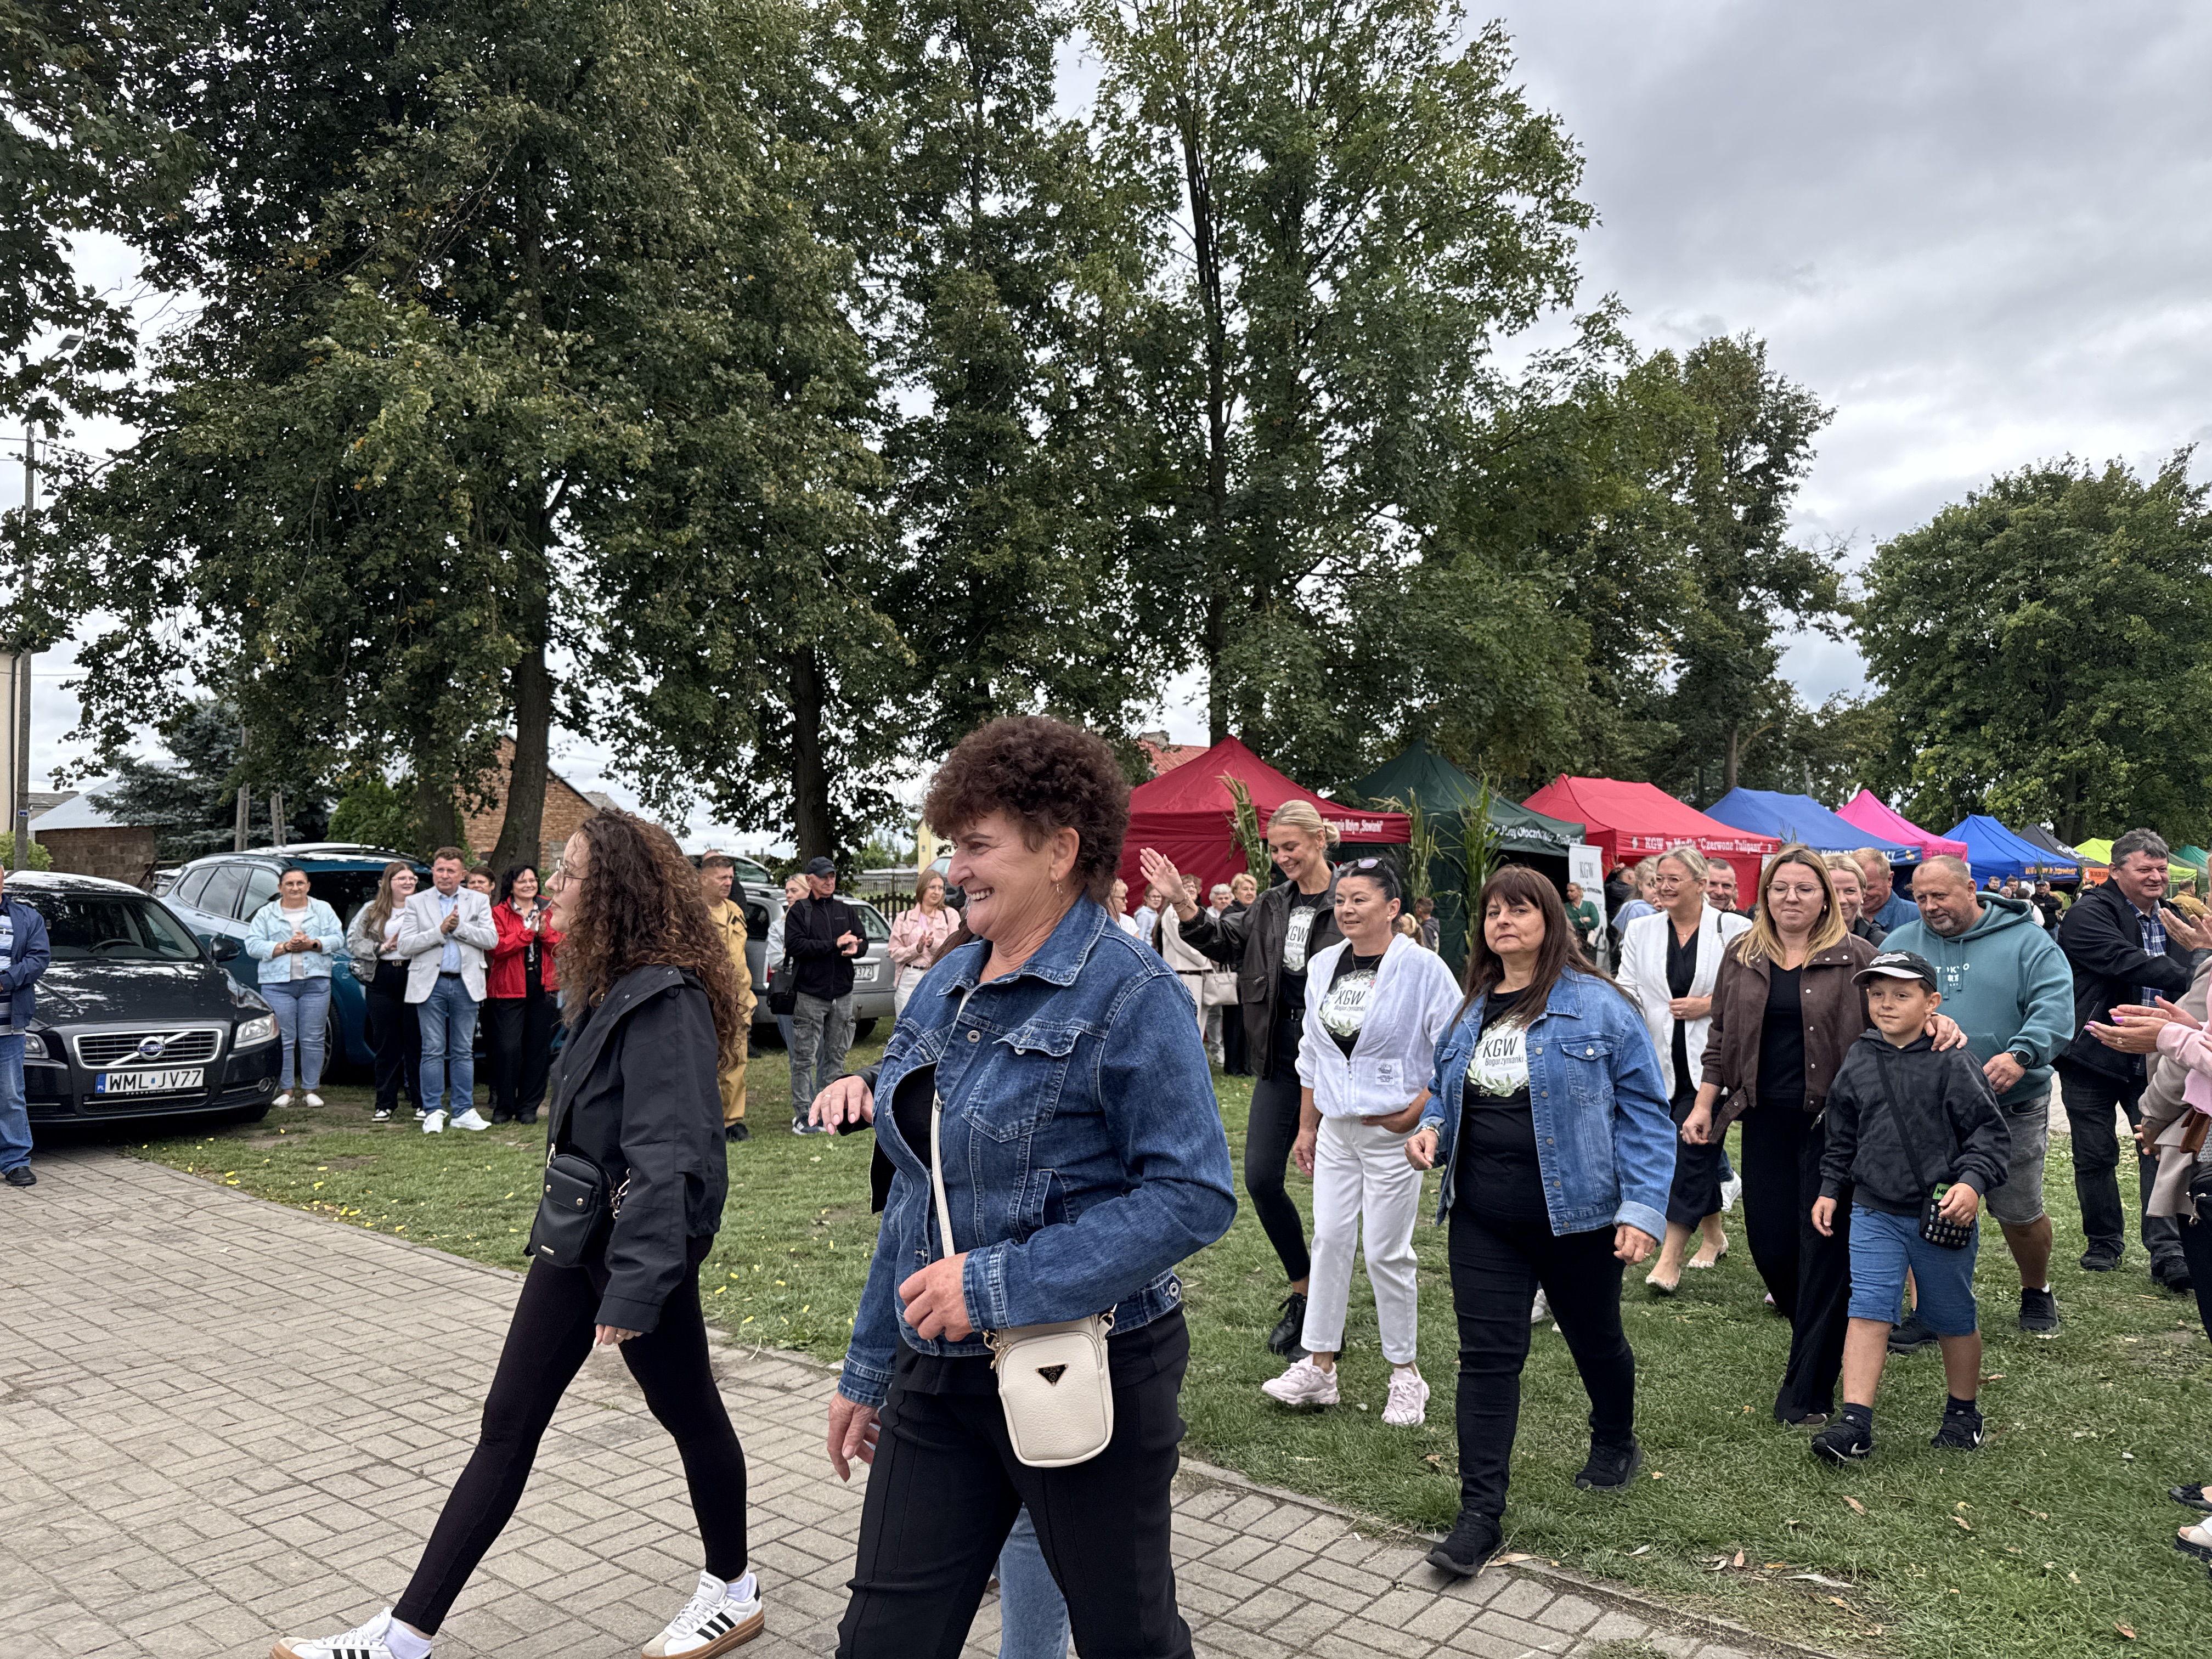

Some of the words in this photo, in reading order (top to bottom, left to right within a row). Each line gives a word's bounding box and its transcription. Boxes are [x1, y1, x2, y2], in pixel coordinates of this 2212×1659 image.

[1644, 837, 1664, 850] KGW
[1334, 989, 1366, 1005] KGW
[1482, 1036, 1518, 1058] KGW
[1485, 1054, 1524, 1067] Bogurzynianki
[110, 1074, 149, 1091] WML
[158, 1070, 201, 1088] JV77
